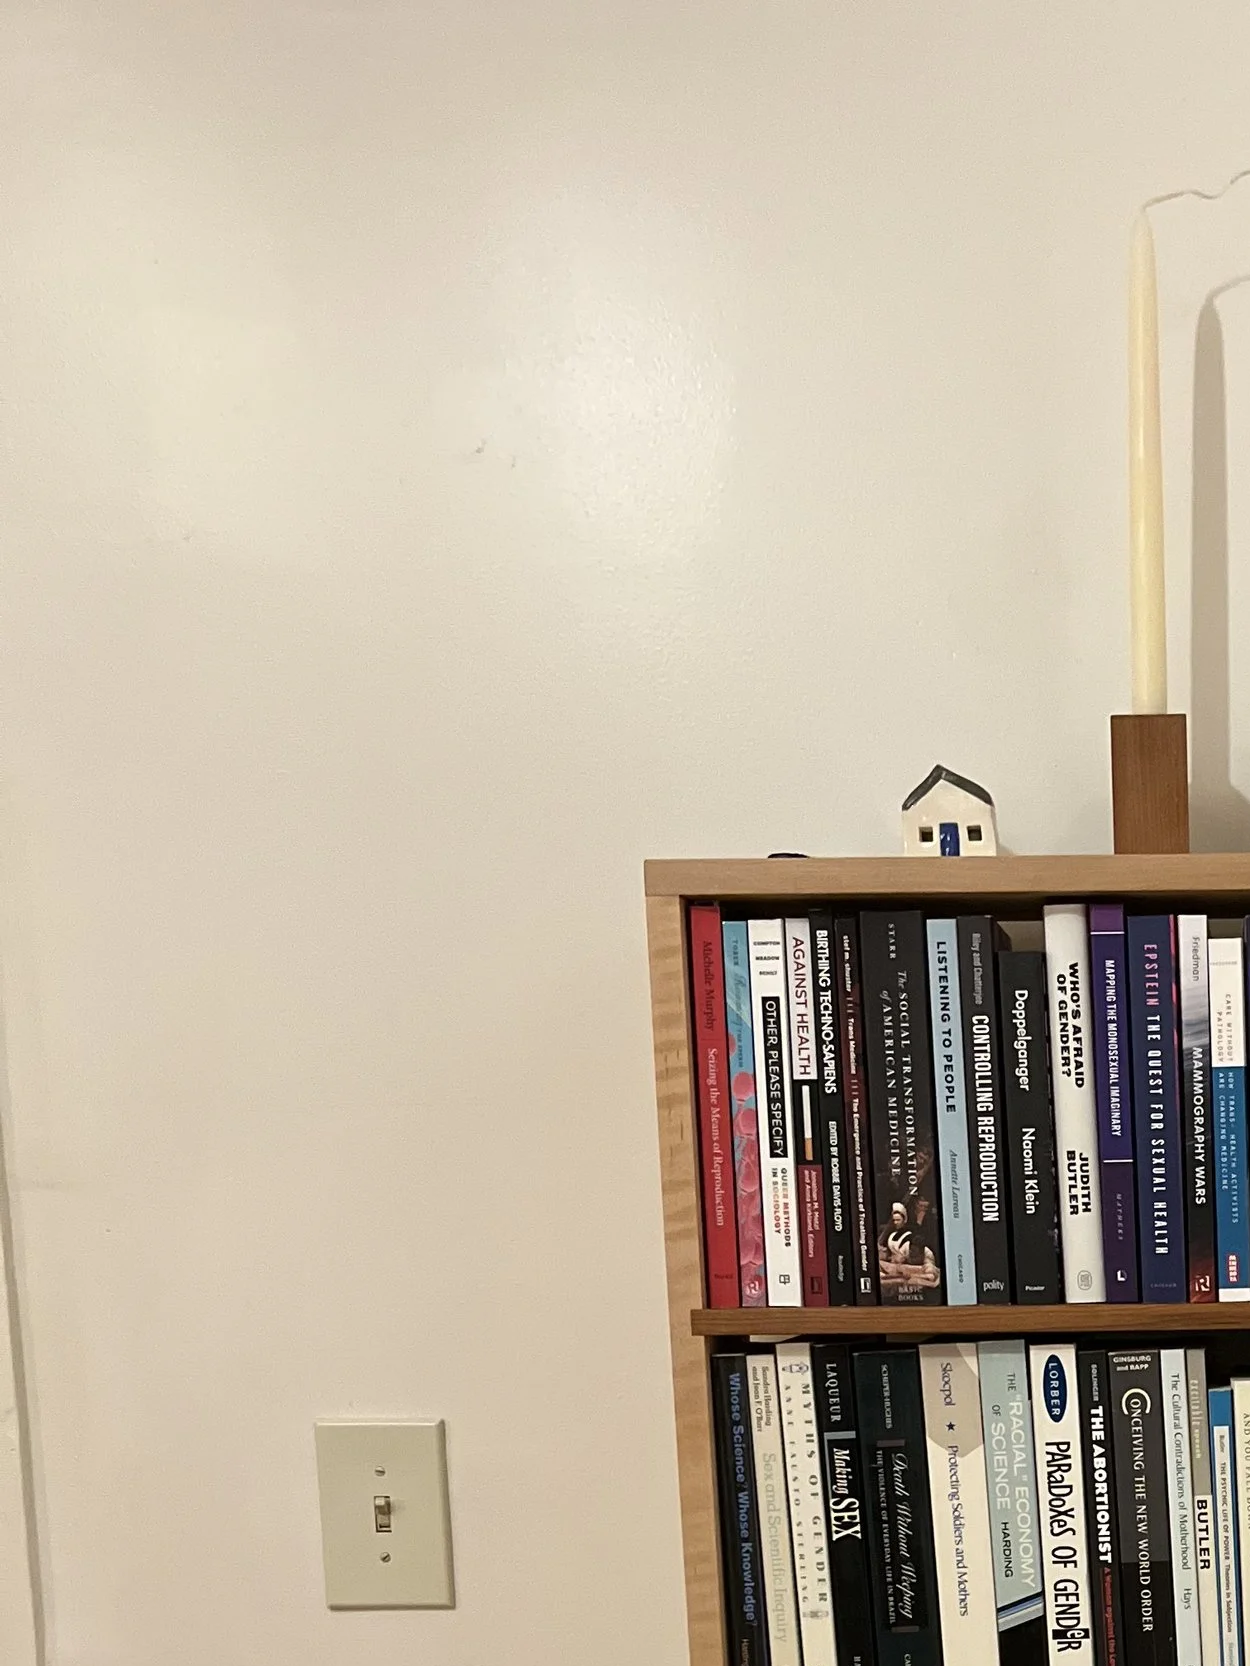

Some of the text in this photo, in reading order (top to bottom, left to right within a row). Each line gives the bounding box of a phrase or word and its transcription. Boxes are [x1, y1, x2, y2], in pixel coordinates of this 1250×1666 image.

[792, 937, 810, 1075] AGAINST HEALTH
[1144, 944, 1160, 1005] EPSTEIN
[1191, 936, 1201, 981] Friedman
[815, 930, 837, 1093] BIRTHING TECHNO-SAPIENS
[937, 942, 956, 1113] LISTENING TO PEOPLE
[1014, 990, 1031, 1091] Doppelganger
[1057, 974, 1072, 1077] OF GENDER?
[1068, 963, 1085, 1088] WHO'S AFRAID
[765, 1001, 785, 1156] OTHER, PLEASE SPECIFY
[972, 1015, 999, 1222] CONTROLLING REPRODUCTION
[1191, 1047, 1207, 1204] MAMMOGRAPHY WARS
[1021, 1128, 1040, 1214] Naomi Klein
[1067, 1150, 1080, 1215] BUTLER
[1079, 1152, 1092, 1213] JUDITH
[1146, 1015, 1169, 1254] THE QUEST FOR SEXUAL HEALTH
[826, 1363, 841, 1422] LAQUEUR
[941, 1363, 955, 1406] Skocpol
[1048, 1363, 1062, 1416] LORBER
[830, 1448, 861, 1540] Making SEX
[946, 1445, 970, 1616] Protecting Soldiers and Mothers
[1091, 1406, 1112, 1563] THE ABORTIONIST
[1197, 1499, 1210, 1569] BUTLER
